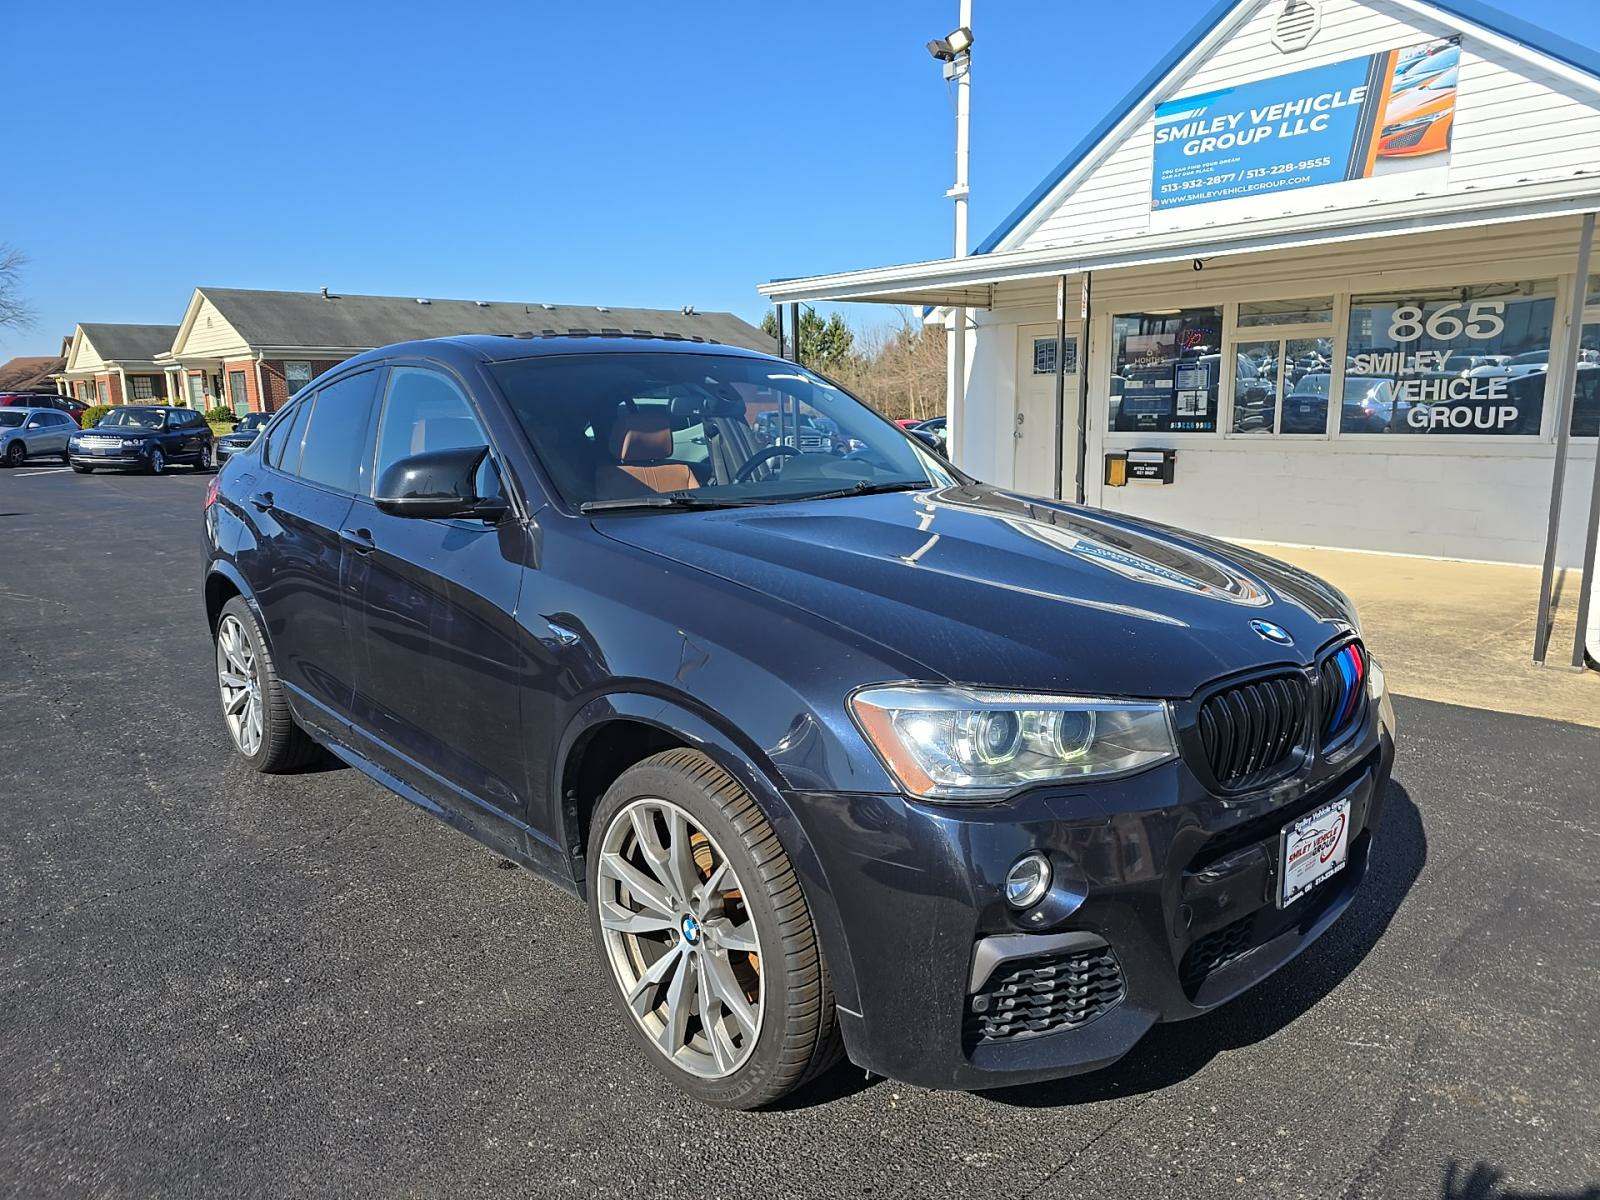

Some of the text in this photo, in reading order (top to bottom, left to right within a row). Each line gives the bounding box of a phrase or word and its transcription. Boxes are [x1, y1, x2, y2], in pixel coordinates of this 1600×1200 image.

[1155, 85, 1368, 144] SMILEY VEHICLE
[1183, 114, 1330, 156] GROUP LLC
[1161, 173, 1236, 193] 513-932-2877
[1246, 156, 1331, 179] 513-228-9555
[1162, 168, 1174, 176] YOU
[1219, 157, 1241, 165] DREAM
[1161, 175, 1312, 205] WWW.SMILEYVEHICLEGROUP.COM
[1387, 301, 1505, 342] 865
[1134, 356, 1166, 364] MONTHS
[1353, 350, 1453, 376] SMILEY
[1387, 377, 1508, 402] VEHICLE
[1407, 406, 1519, 429] GROUP
[1288, 827, 1338, 864] SMILEY VEHICLE
